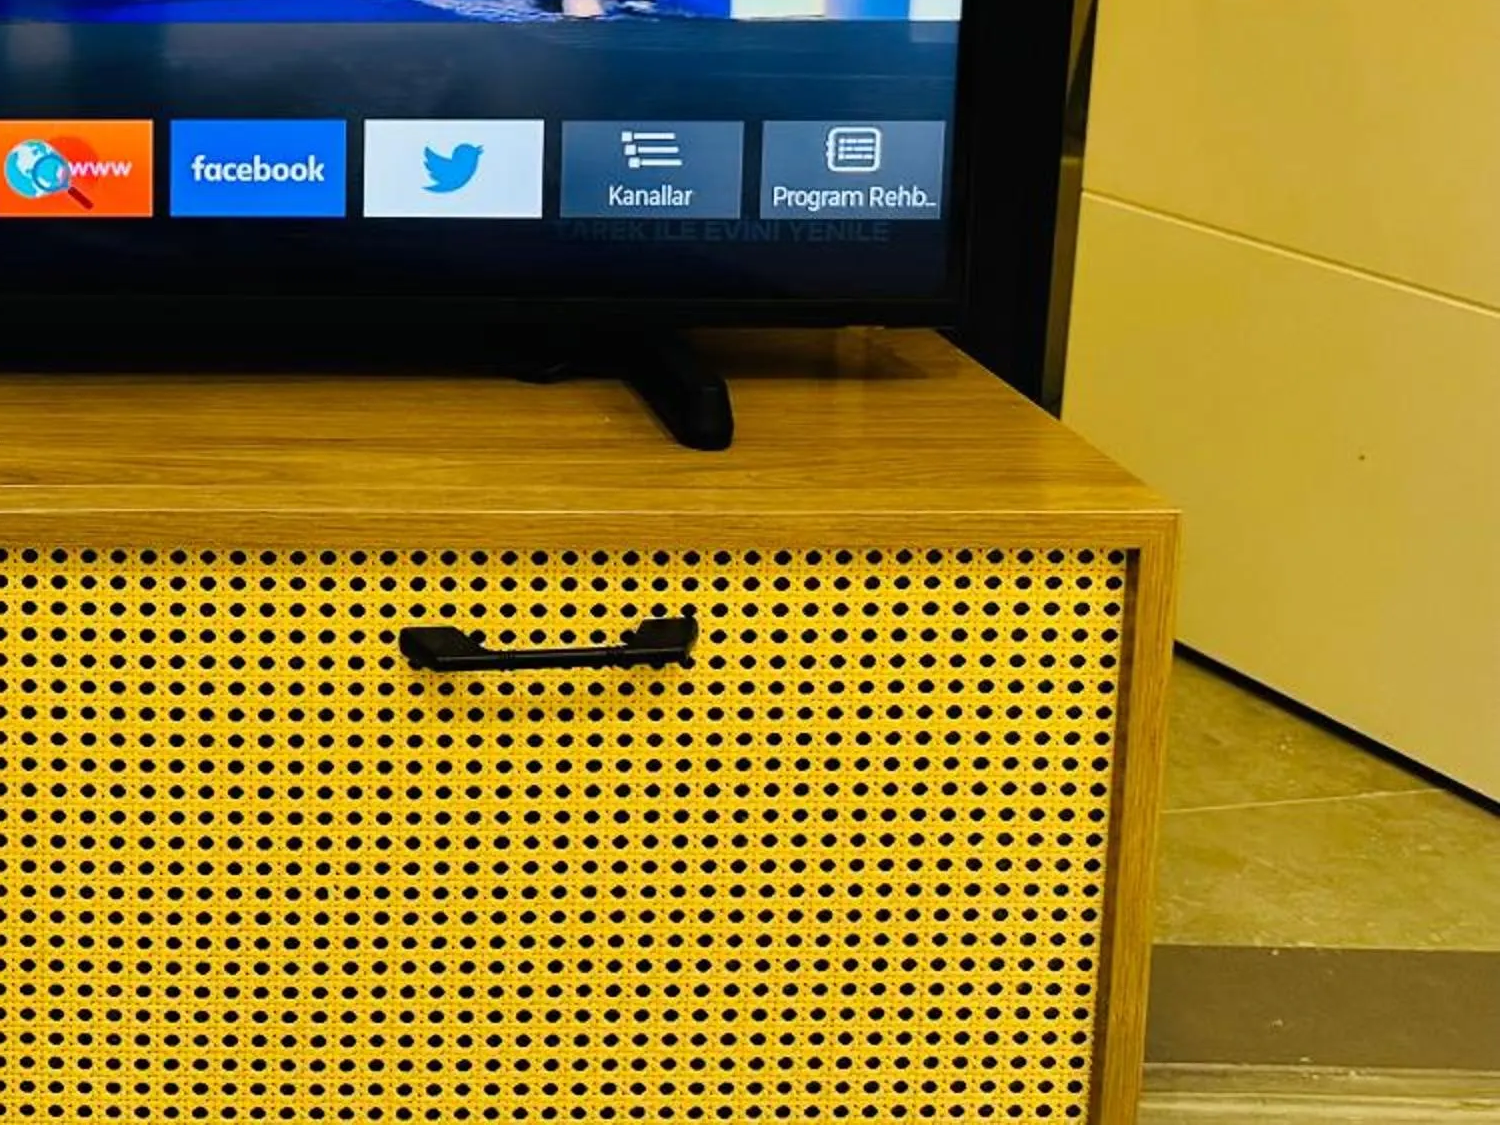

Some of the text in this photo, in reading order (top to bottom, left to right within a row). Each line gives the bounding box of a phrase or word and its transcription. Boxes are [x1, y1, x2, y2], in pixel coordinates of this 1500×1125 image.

[191, 155, 325, 183] facebook
[608, 185, 693, 207] Kanallar
[772, 186, 864, 212] Program
